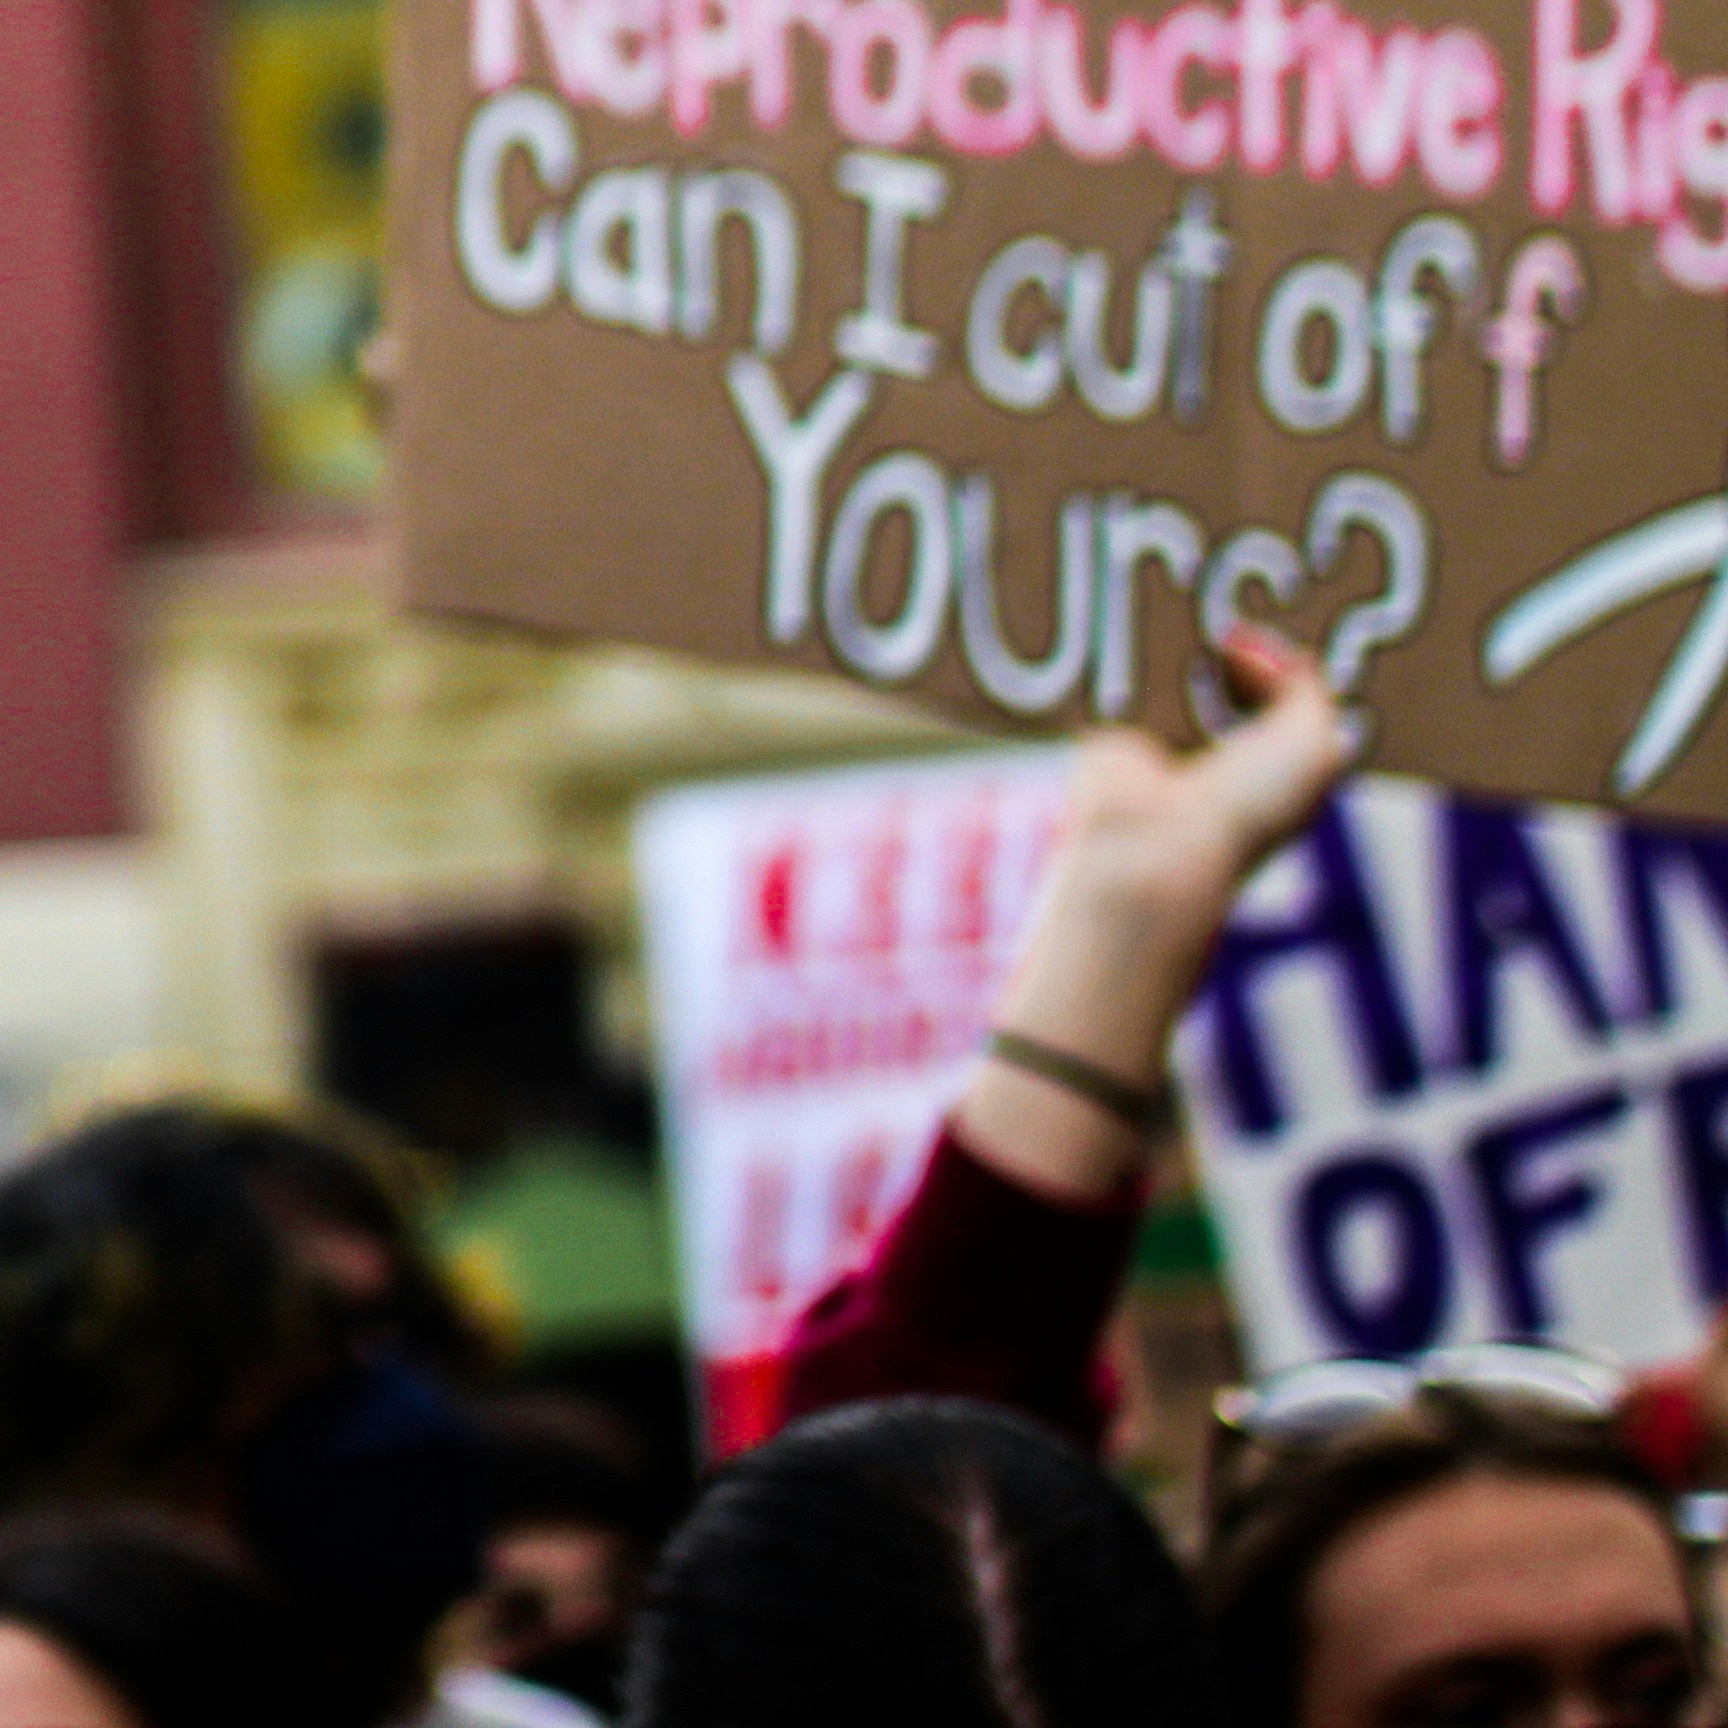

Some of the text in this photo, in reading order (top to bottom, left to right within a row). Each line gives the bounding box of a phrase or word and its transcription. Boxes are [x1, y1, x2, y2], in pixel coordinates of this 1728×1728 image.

[454, 89, 798, 354] Can
[834, 148, 948, 380] I
[966, 187, 1231, 422] cut
[726, 351, 1428, 760] Yours?
